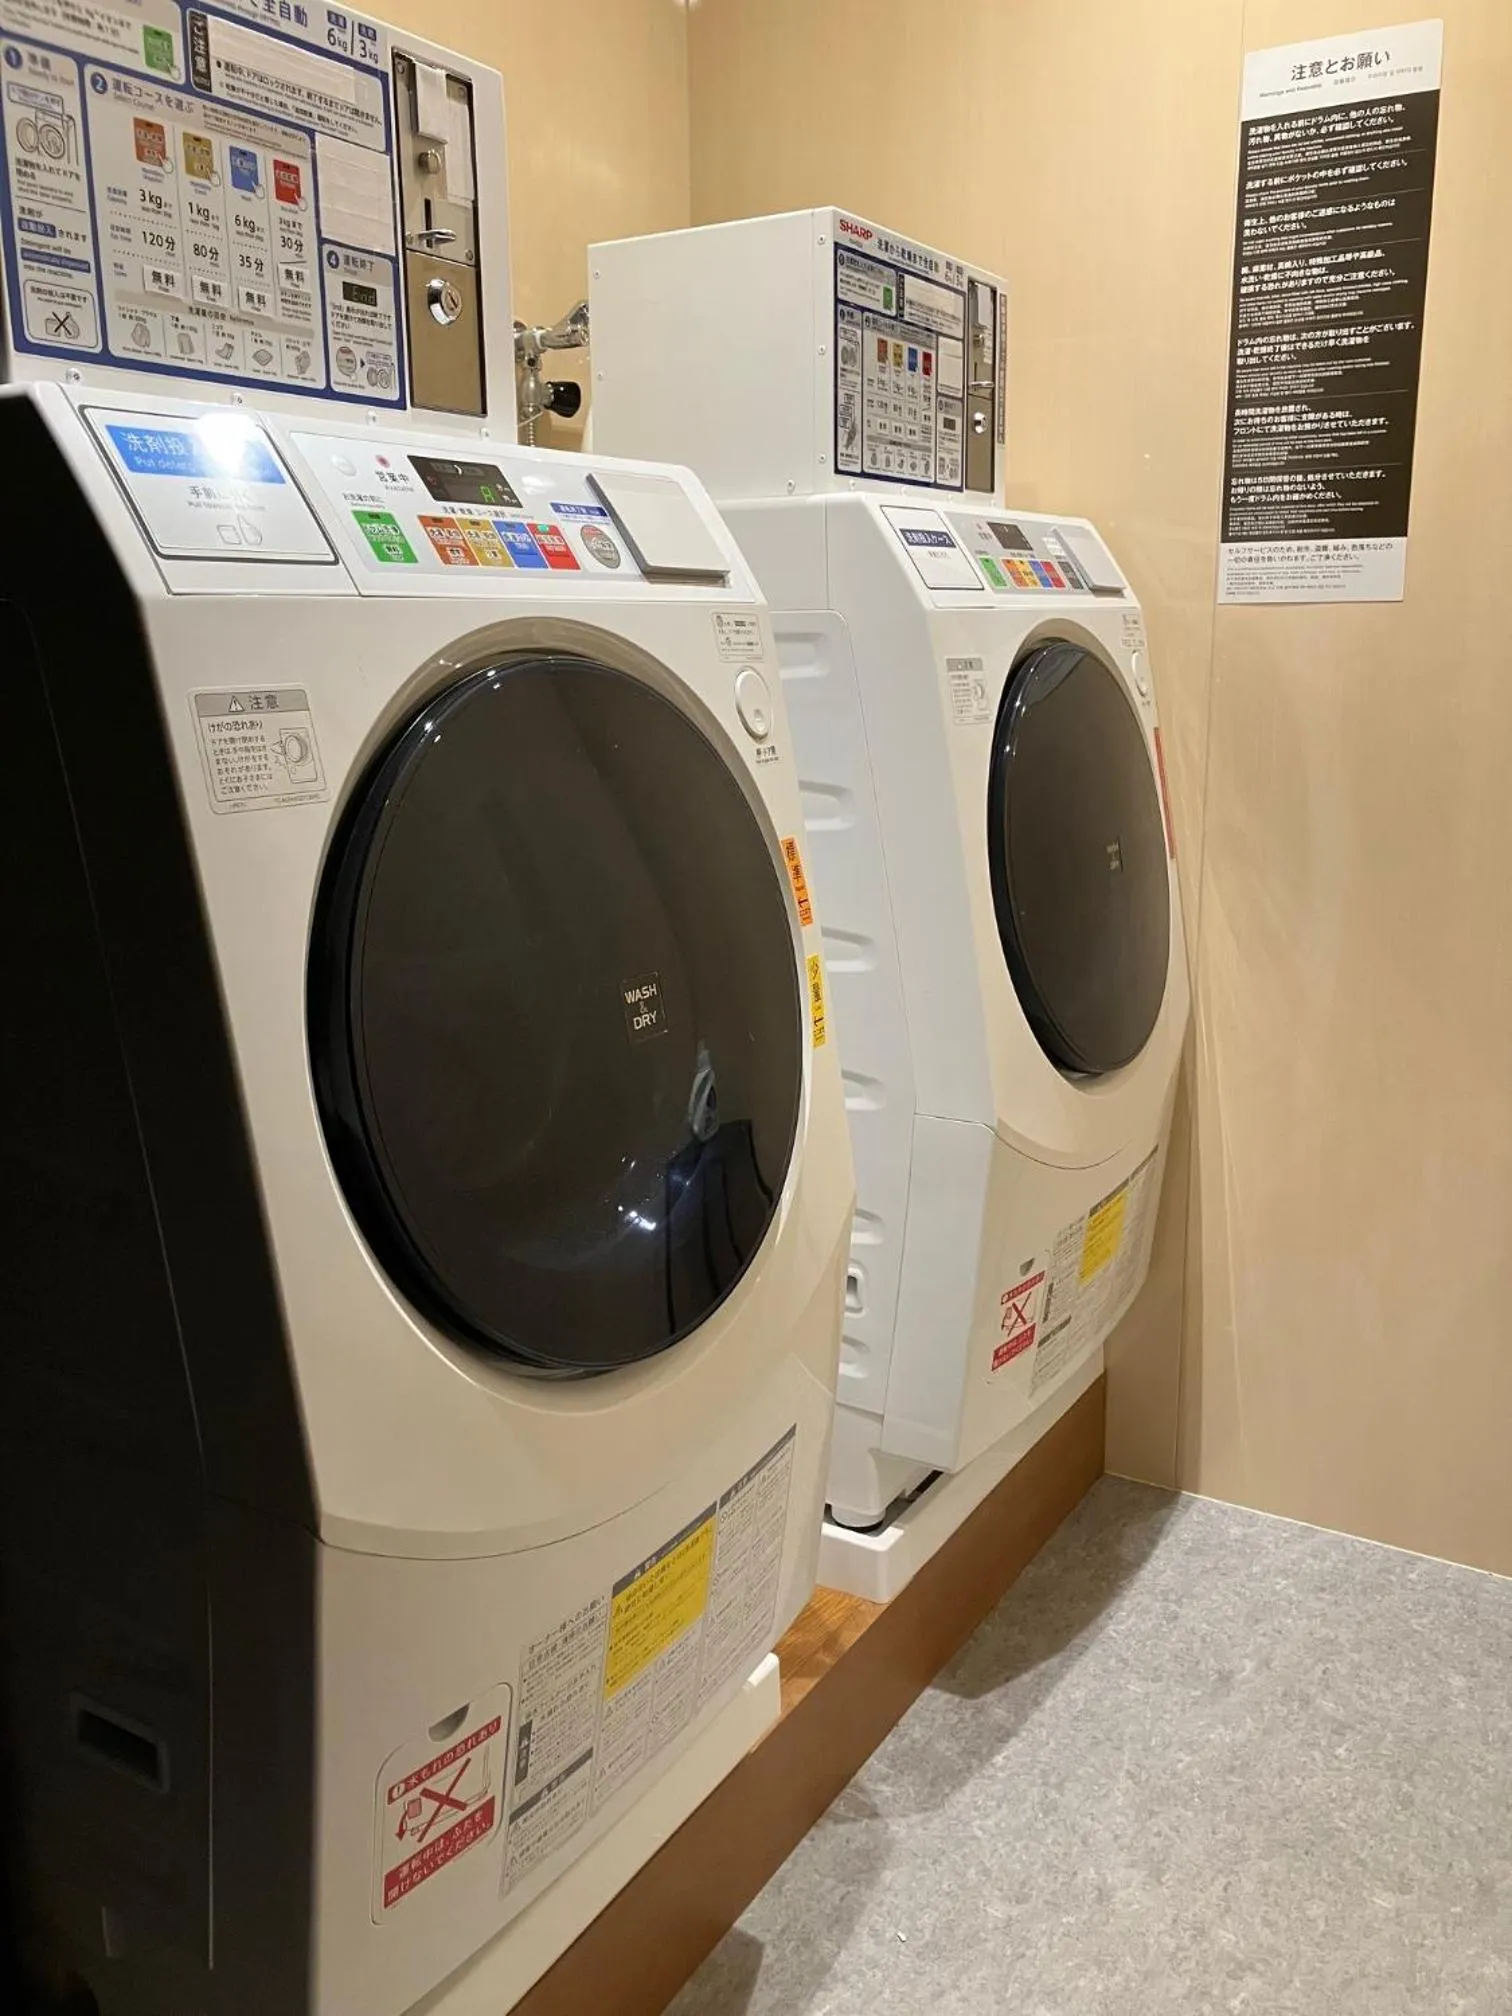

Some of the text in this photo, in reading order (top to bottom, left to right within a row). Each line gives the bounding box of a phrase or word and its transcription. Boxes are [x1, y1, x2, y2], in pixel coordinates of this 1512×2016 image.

[1290, 50, 1391, 81] 注意とお願い
[113, 79, 194, 113] 運転コースを選ぶ
[839, 219, 873, 240] SHARP
[1243, 222, 1307, 238] 洗わないでください。
[142, 231, 176, 251] 120分
[280, 235, 304, 253] 30分
[193, 243, 220, 262] 80分
[239, 254, 264, 272] 35分
[151, 270, 176, 288] 無料
[284, 268, 305, 283] 無料
[200, 281, 222, 297] 無料
[245, 291, 267, 308] 無料
[1236, 354, 1297, 365] 取り出してください。
[249, 694, 280, 711] 注意
[624, 983, 658, 1004] WASH
[633, 1010, 657, 1030] DRY
[407, 1721, 499, 1787] 水もれの恐れあり
[399, 1810, 484, 1879] 運転中は、ふたを
[387, 1820, 492, 1902] 開けないでください。
